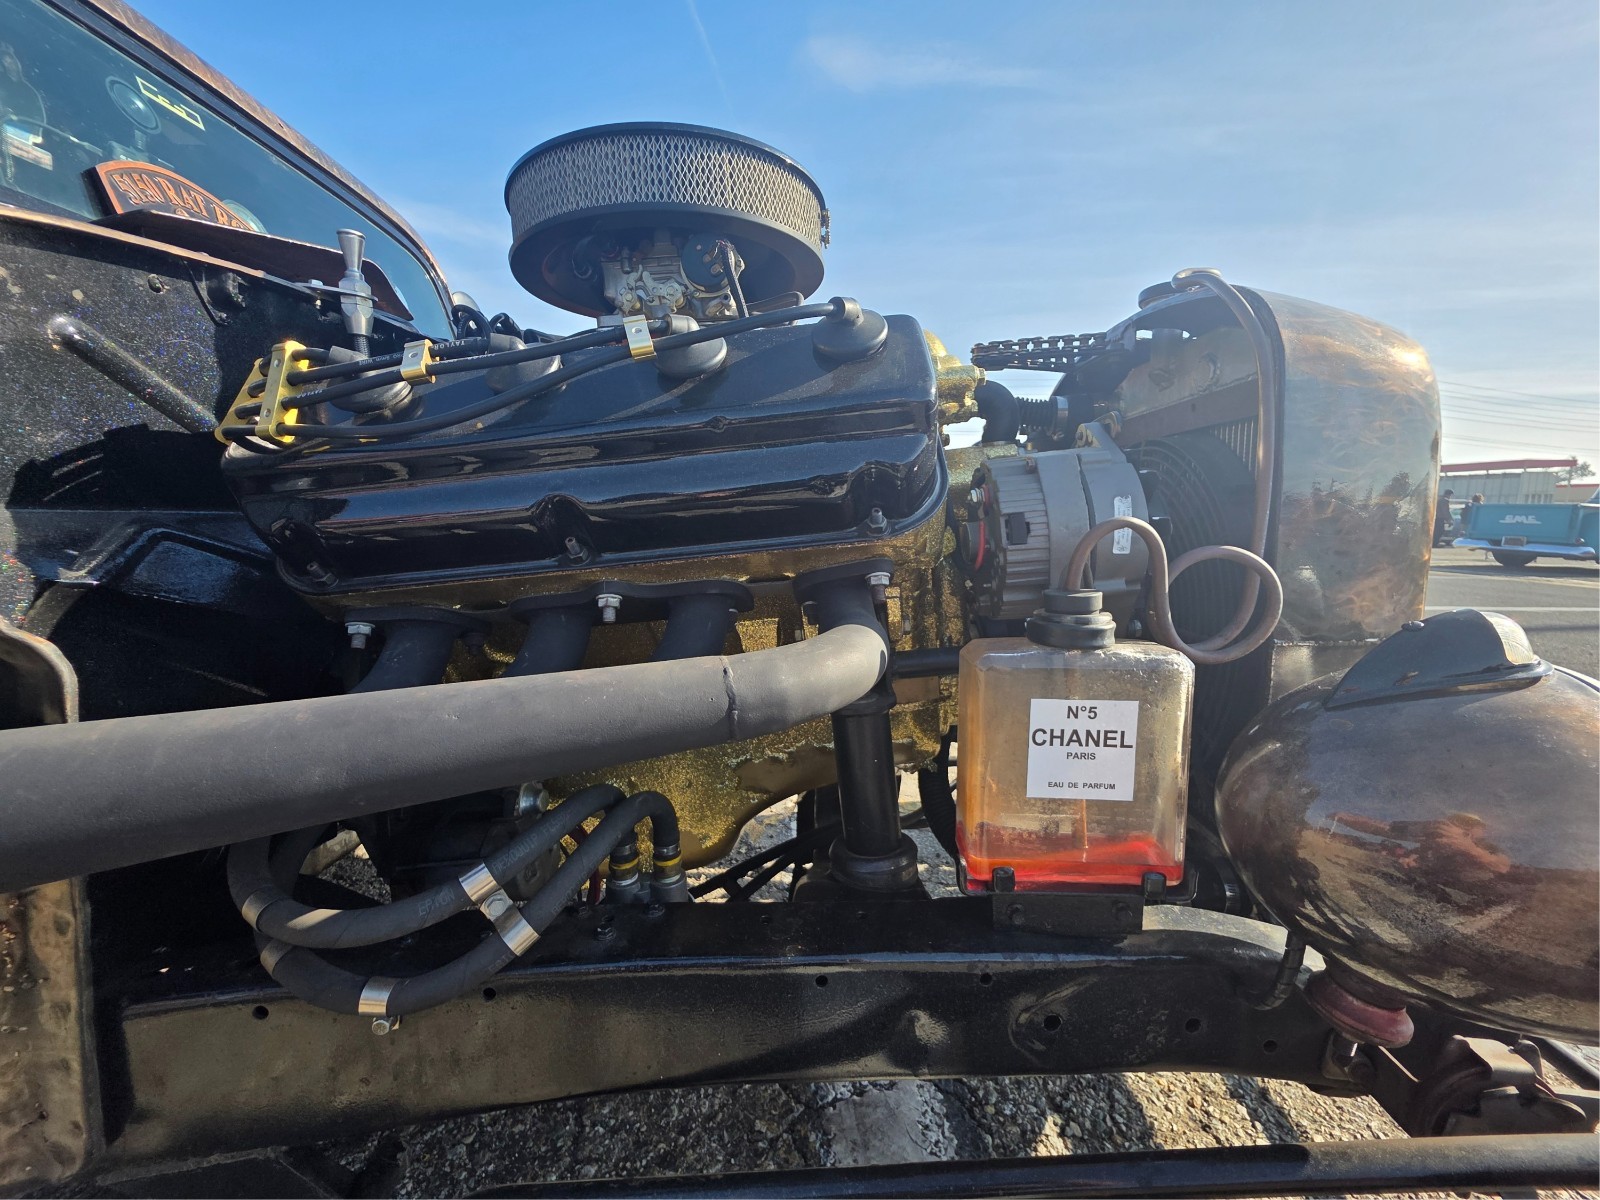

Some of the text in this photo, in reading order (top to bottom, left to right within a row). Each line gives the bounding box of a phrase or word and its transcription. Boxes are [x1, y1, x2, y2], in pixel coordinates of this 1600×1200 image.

[111, 173, 165, 205] 5150
[154, 176, 210, 218] RAT
[434, 340, 465, 351] TAYLOR
[1031, 728, 1134, 749] CHANEL
[1066, 752, 1096, 760] PARIS
